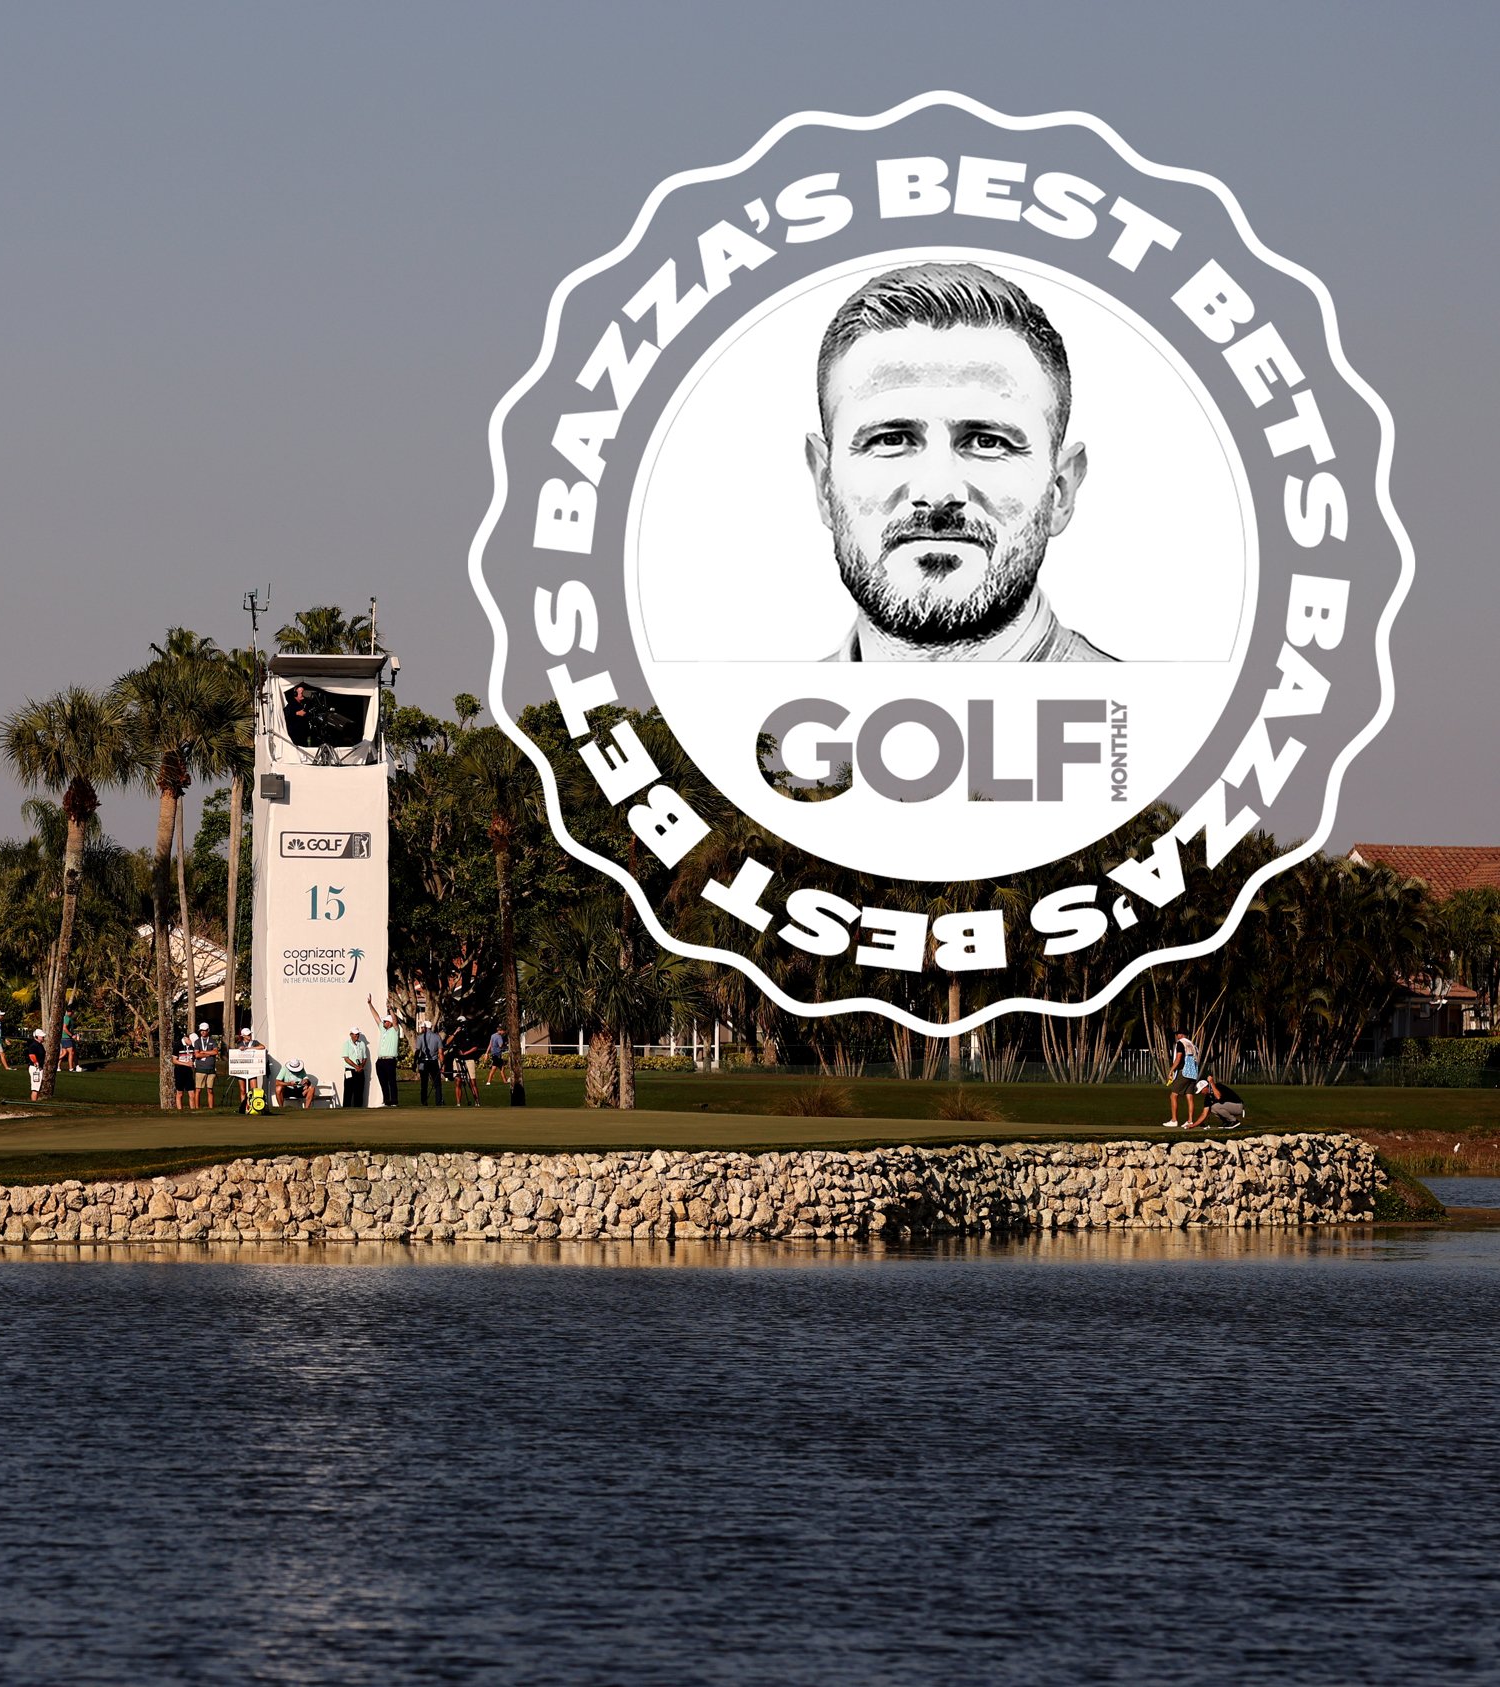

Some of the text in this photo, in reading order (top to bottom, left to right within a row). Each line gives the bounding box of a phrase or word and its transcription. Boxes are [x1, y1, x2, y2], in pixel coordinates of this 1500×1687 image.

[307, 838, 342, 851] GOLF
[305, 885, 345, 921] 15
[283, 947, 345, 961] cognizant
[283, 959, 345, 976] classic
